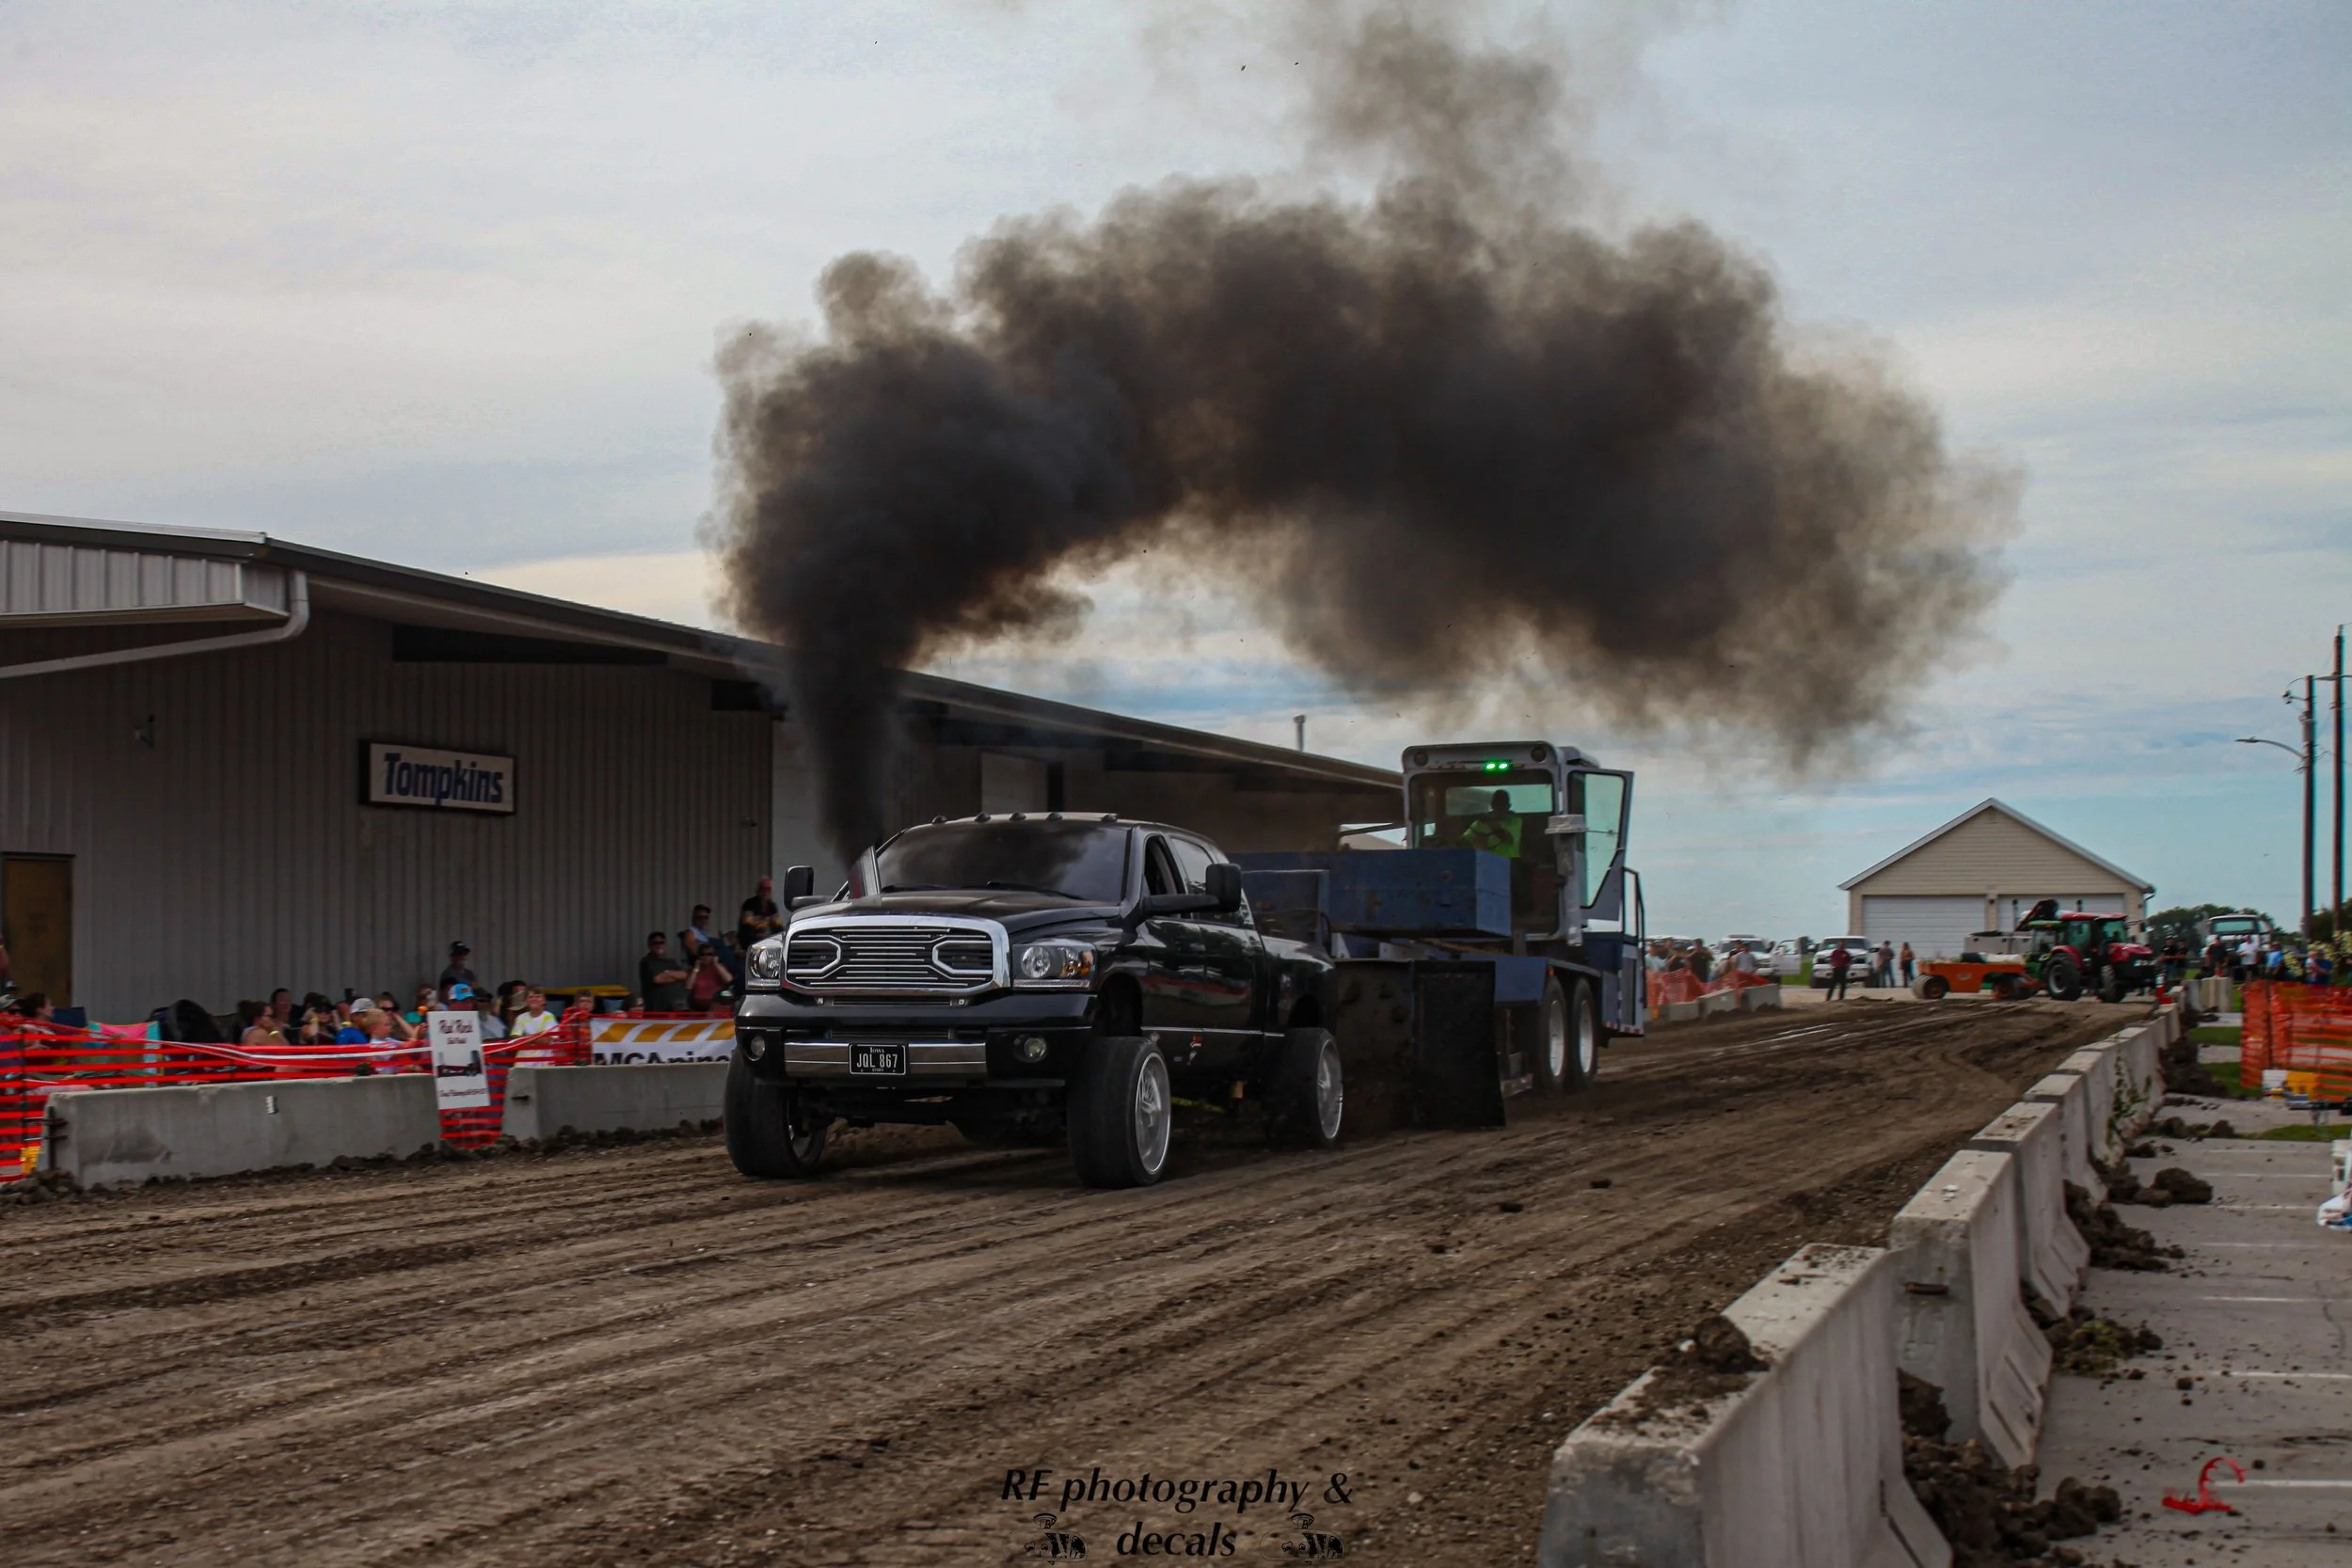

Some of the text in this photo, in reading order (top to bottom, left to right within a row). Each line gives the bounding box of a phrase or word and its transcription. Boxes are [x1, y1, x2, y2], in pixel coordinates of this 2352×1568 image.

[385, 752, 503, 805] Tompkins
[857, 1053, 898, 1069] JQL 867
